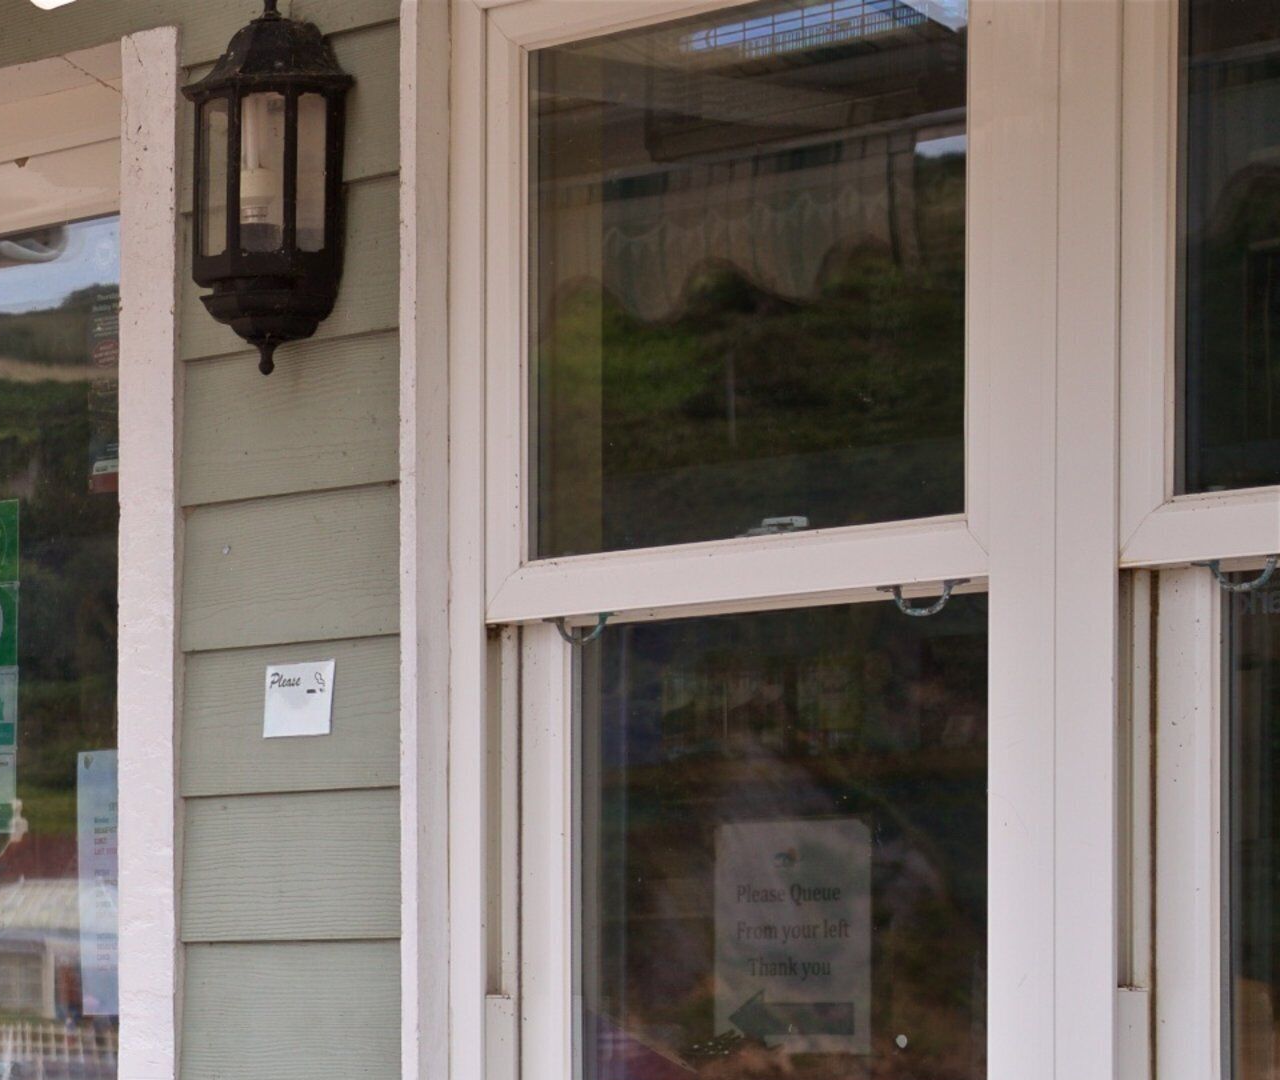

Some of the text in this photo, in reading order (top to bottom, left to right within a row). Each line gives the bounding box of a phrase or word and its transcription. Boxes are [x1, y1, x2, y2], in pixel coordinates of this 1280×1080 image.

[269, 671, 302, 690] Please
[736, 883, 841, 906] Please Queue
[736, 919, 852, 944] From your left
[748, 957, 832, 981] Thank you
